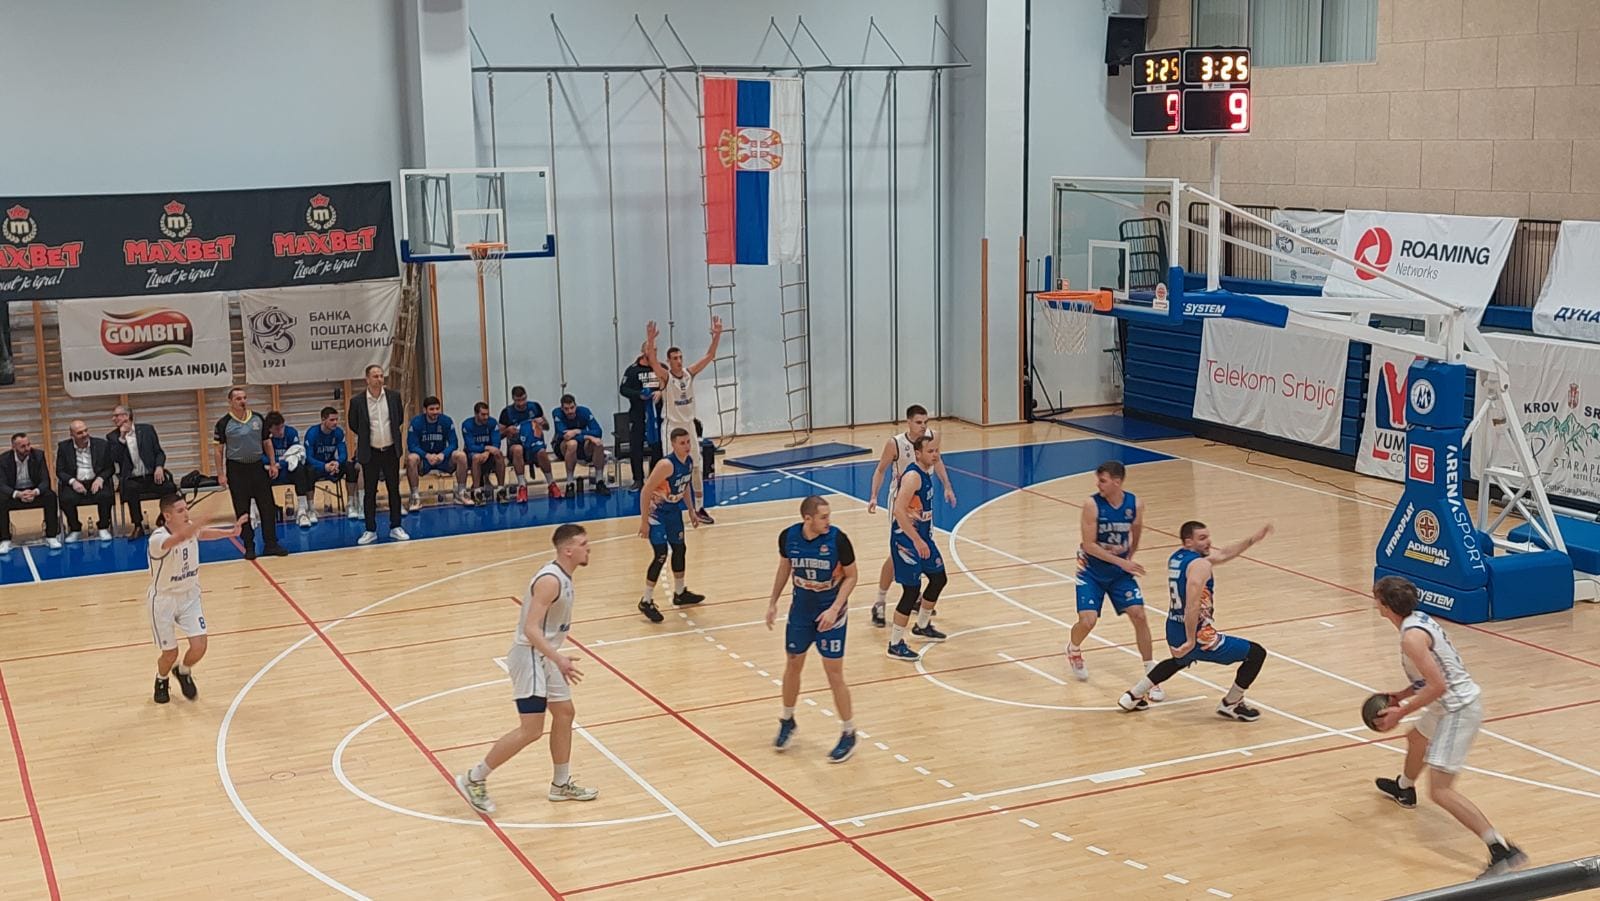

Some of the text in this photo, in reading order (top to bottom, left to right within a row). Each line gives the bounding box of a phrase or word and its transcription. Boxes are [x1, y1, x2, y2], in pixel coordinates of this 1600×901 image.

[1146, 57, 1179, 82] 3:25
[1201, 55, 1248, 81] 3:25
[1166, 93, 1179, 130] 9
[1229, 92, 1248, 130] 9
[123, 235, 236, 265] MAXBET
[272, 226, 377, 257] MAXBET
[1400, 240, 1491, 265] ROAMING
[1395, 262, 1440, 281] Networks
[309, 310, 351, 322] БАНКА
[104, 322, 187, 344] GOMBIT
[310, 322, 388, 336] ПОШТАНСКА
[262, 358, 287, 368] 1921
[68, 367, 145, 382] INDUSTRIJA
[148, 365, 183, 377] MESA
[1206, 359, 1336, 410] Telekom Srbija
[1523, 402, 1560, 414] KROV
[1385, 502, 1415, 558] HYDROPLAY
[182, 547, 189, 561] 8
[1407, 540, 1451, 560] ADMIRAL
[805, 569, 817, 580] 13
[198, 616, 206, 629] 8
[830, 639, 841, 652] 13
